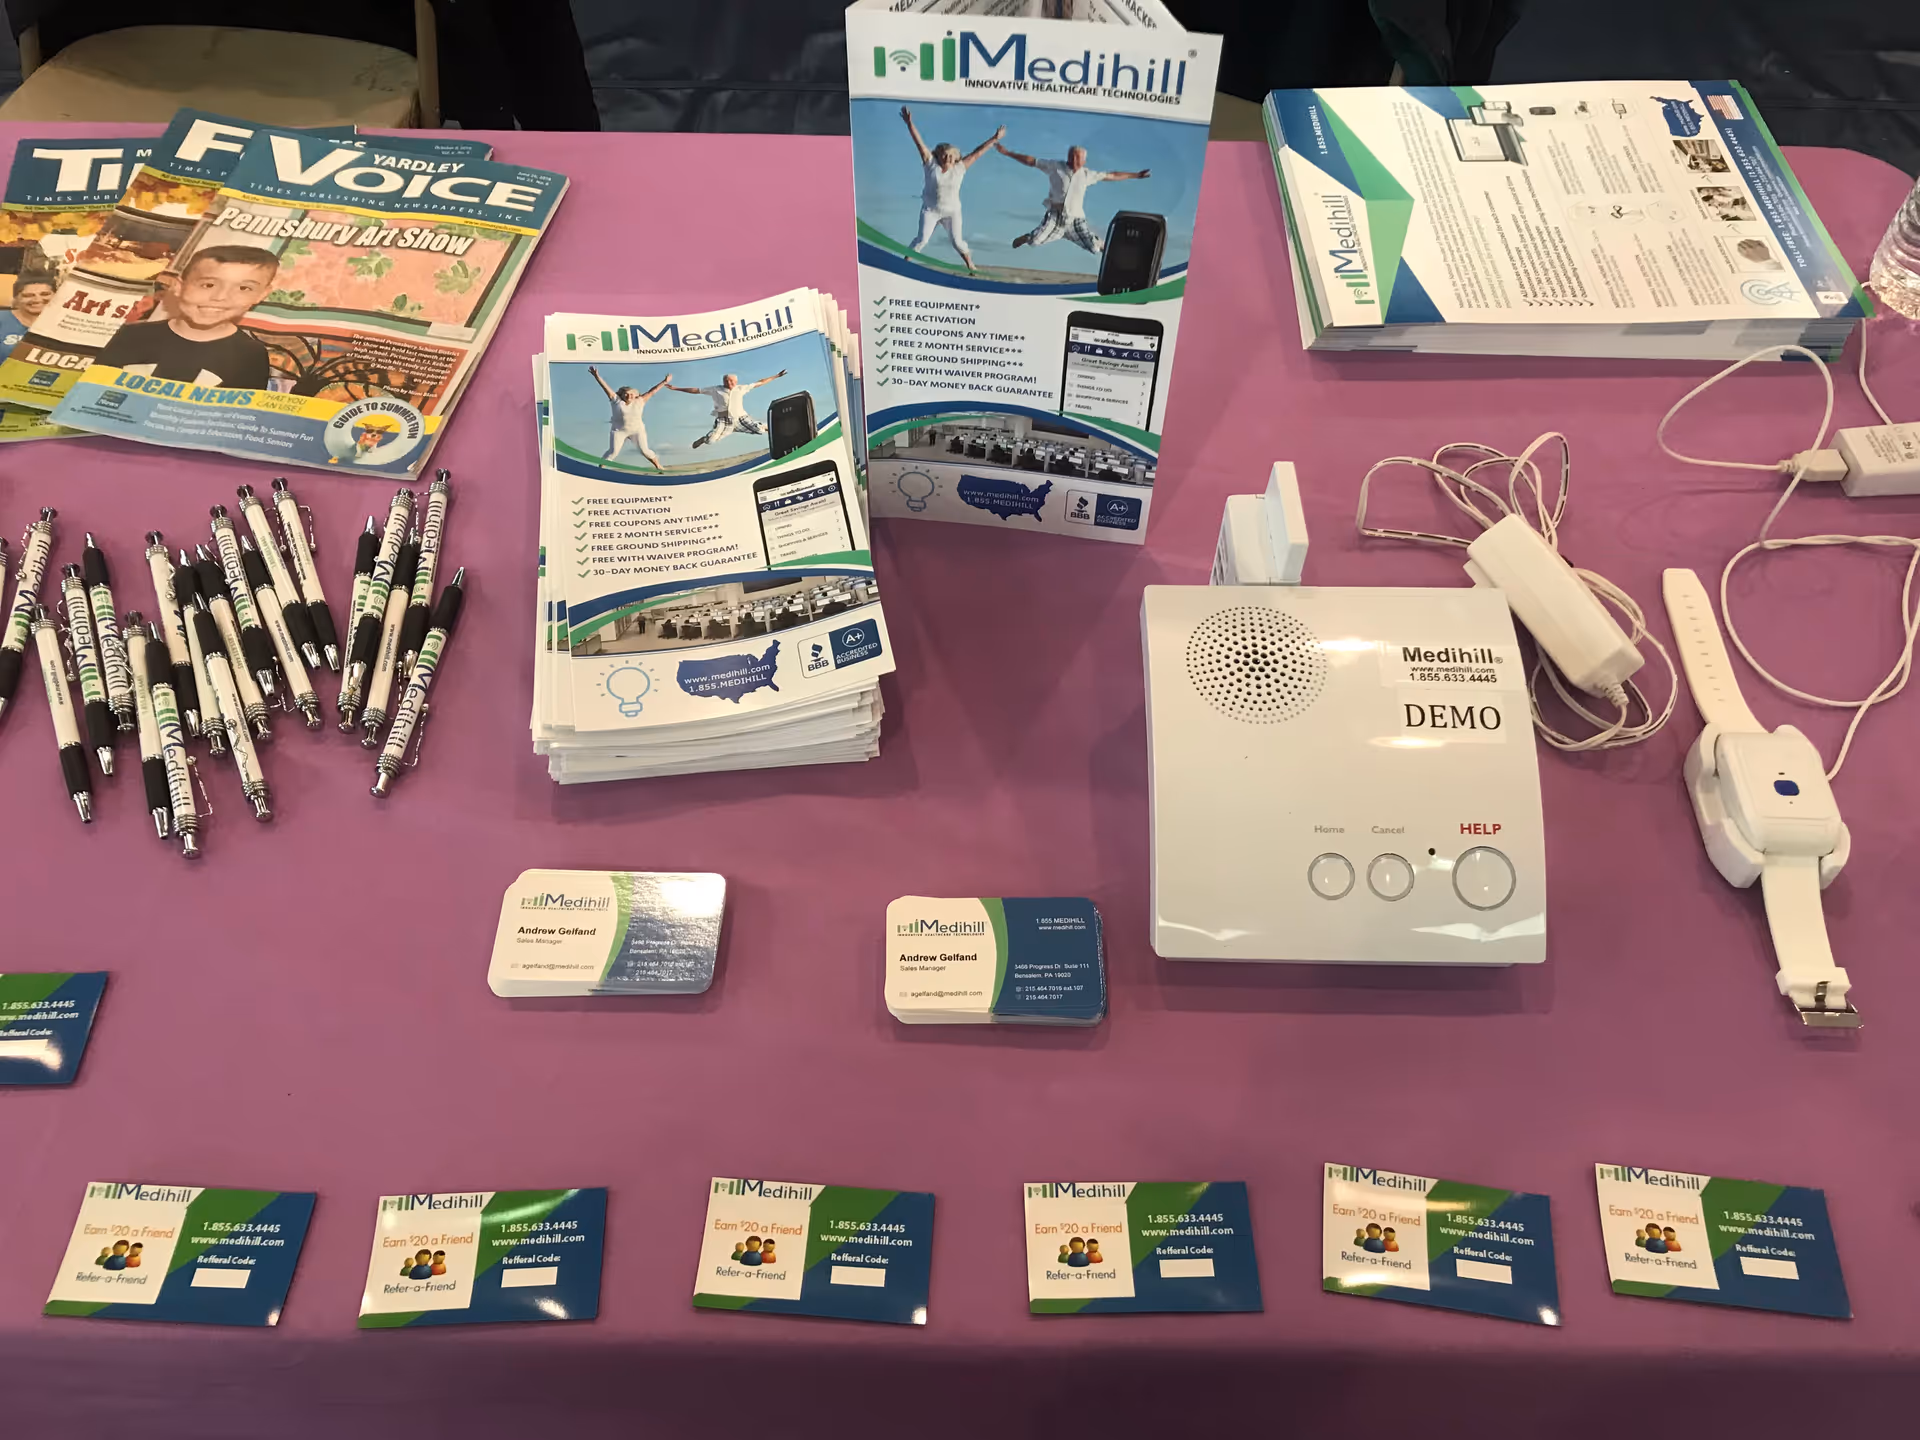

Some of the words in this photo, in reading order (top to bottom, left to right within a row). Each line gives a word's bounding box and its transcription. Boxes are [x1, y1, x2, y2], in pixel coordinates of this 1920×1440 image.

[965, 79, 1028, 91] INNOVATIVE
[1032, 83, 1098, 96] HEALTHCARE
[1102, 88, 1180, 105] TECHNOLOGIES
[1308, 105, 1328, 154] 1.855.MEDIHILL
[373, 154, 465, 174] YARDLEY
[250, 183, 292, 194] TIMES
[300, 191, 386, 206] PUBLISHING
[394, 203, 489, 216] NEWSPAPERS,
[498, 212, 528, 223] INC.
[212, 206, 354, 246] Pennsbury
[357, 225, 400, 246] Art
[397, 227, 473, 255] Show
[62, 290, 112, 316] Art
[889, 299, 912, 307] FREE
[890, 313, 912, 321] FREE
[915, 315, 976, 325] ACTIVATION
[687, 340, 736, 351] HEALTHCARE
[738, 324, 793, 342] TECHNOLOGIES
[890, 326, 912, 334] FREE
[915, 328, 964, 337] COUPONS
[925, 342, 964, 351] MONTH
[25, 348, 96, 370] LOCA
[915, 355, 958, 363] GROUND
[916, 367, 942, 375] WITH
[944, 369, 982, 378] WAIVER
[984, 372, 1037, 383] PROGRAM!
[114, 371, 185, 399] LOCAL
[189, 387, 255, 406] NEWS
[892, 378, 928, 386] 30-DAY
[930, 381, 966, 389] MONEY
[969, 384, 993, 392] BACK
[996, 386, 1053, 398] GUARANTEE
[287, 395, 307, 405] YOU
[333, 406, 365, 428] GUIDE
[364, 402, 378, 411] TO
[380, 402, 416, 424] SUMMER
[407, 422, 419, 439] FUN
[269, 428, 299, 439] Summer
[300, 432, 314, 441] Fun
[964, 490, 1039, 503] www.medihill.com
[613, 507, 670, 515] ACTIVATION
[1109, 503, 1126, 511] A+
[1071, 512, 1090, 520] BBB
[614, 519, 661, 527] COUPONS
[616, 542, 659, 550] GROUND
[647, 552, 685, 560] WAIVER
[687, 544, 738, 557] PROGRAM!
[633, 565, 670, 573] MONEY
[673, 563, 698, 571] BACK
[700, 552, 757, 568] GUARANTEE
[845, 632, 862, 644] A+
[836, 643, 878, 659] ACCREDITED
[837, 650, 869, 664] BUSINESS
[808, 660, 829, 671] BBB
[684, 664, 770, 684] www.medihill.com
[1410, 673, 1497, 682] 1.855.633.4445
[689, 674, 767, 693] 1.855.MEDIHILL
[1404, 704, 1501, 730] DEMO
[1314, 825, 1344, 833] Home
[1372, 826, 1404, 834] Cancel
[1460, 823, 1501, 835] HELP
[518, 927, 556, 935] Andrew
[900, 954, 937, 962] Andrew
[939, 953, 977, 961] Gelfand
[2, 1000, 75, 1009] 1.855.633.4445
[1147, 1213, 1223, 1223] 1.855.633.4445
[1332, 1204, 1356, 1217] Earn
[1389, 1212, 1420, 1226] Friend
[1609, 1205, 1632, 1217] Earn
[1667, 1211, 1699, 1225] Friend
[1724, 1210, 1803, 1226] 1.855.633.4445
[203, 1222, 280, 1233] 1.855.633.4445
[500, 1221, 577, 1233] 1.855.633.4445
[714, 1219, 737, 1230] Earn
[740, 1220, 759, 1232] $20
[771, 1223, 802, 1235] Friend
[830, 1220, 905, 1232] 1.855.633.4445
[1035, 1224, 1058, 1234] Earn
[1060, 1223, 1079, 1233] $20
[1091, 1223, 1122, 1233] Friend
[1446, 1213, 1524, 1232] 1.855.633.4445
[84, 1224, 108, 1234] Earn
[140, 1227, 174, 1239] Friend
[1142, 1227, 1233, 1236] www.medihill.com
[1440, 1227, 1534, 1246] www.medihill.com
[1719, 1224, 1815, 1240] www.medihill.com
[191, 1235, 284, 1247] www.medihill.com
[383, 1237, 407, 1247] Earn
[410, 1236, 428, 1247] $20
[441, 1233, 473, 1244] Friend
[491, 1234, 585, 1246] www.medihill.com
[820, 1234, 912, 1247] www.medihill.com
[831, 1253, 864, 1263] Refferal
[865, 1256, 888, 1264] Code:
[1341, 1251, 1411, 1270] Refer-a-Friend
[1625, 1252, 1697, 1269] Refer-a-Friend
[76, 1272, 146, 1285] Refer-a-Friend
[716, 1266, 786, 1281] Refer-a-Friend
[1046, 1269, 1116, 1280] Refer-a-Friend
[384, 1281, 456, 1293] Refer-a-Friend
